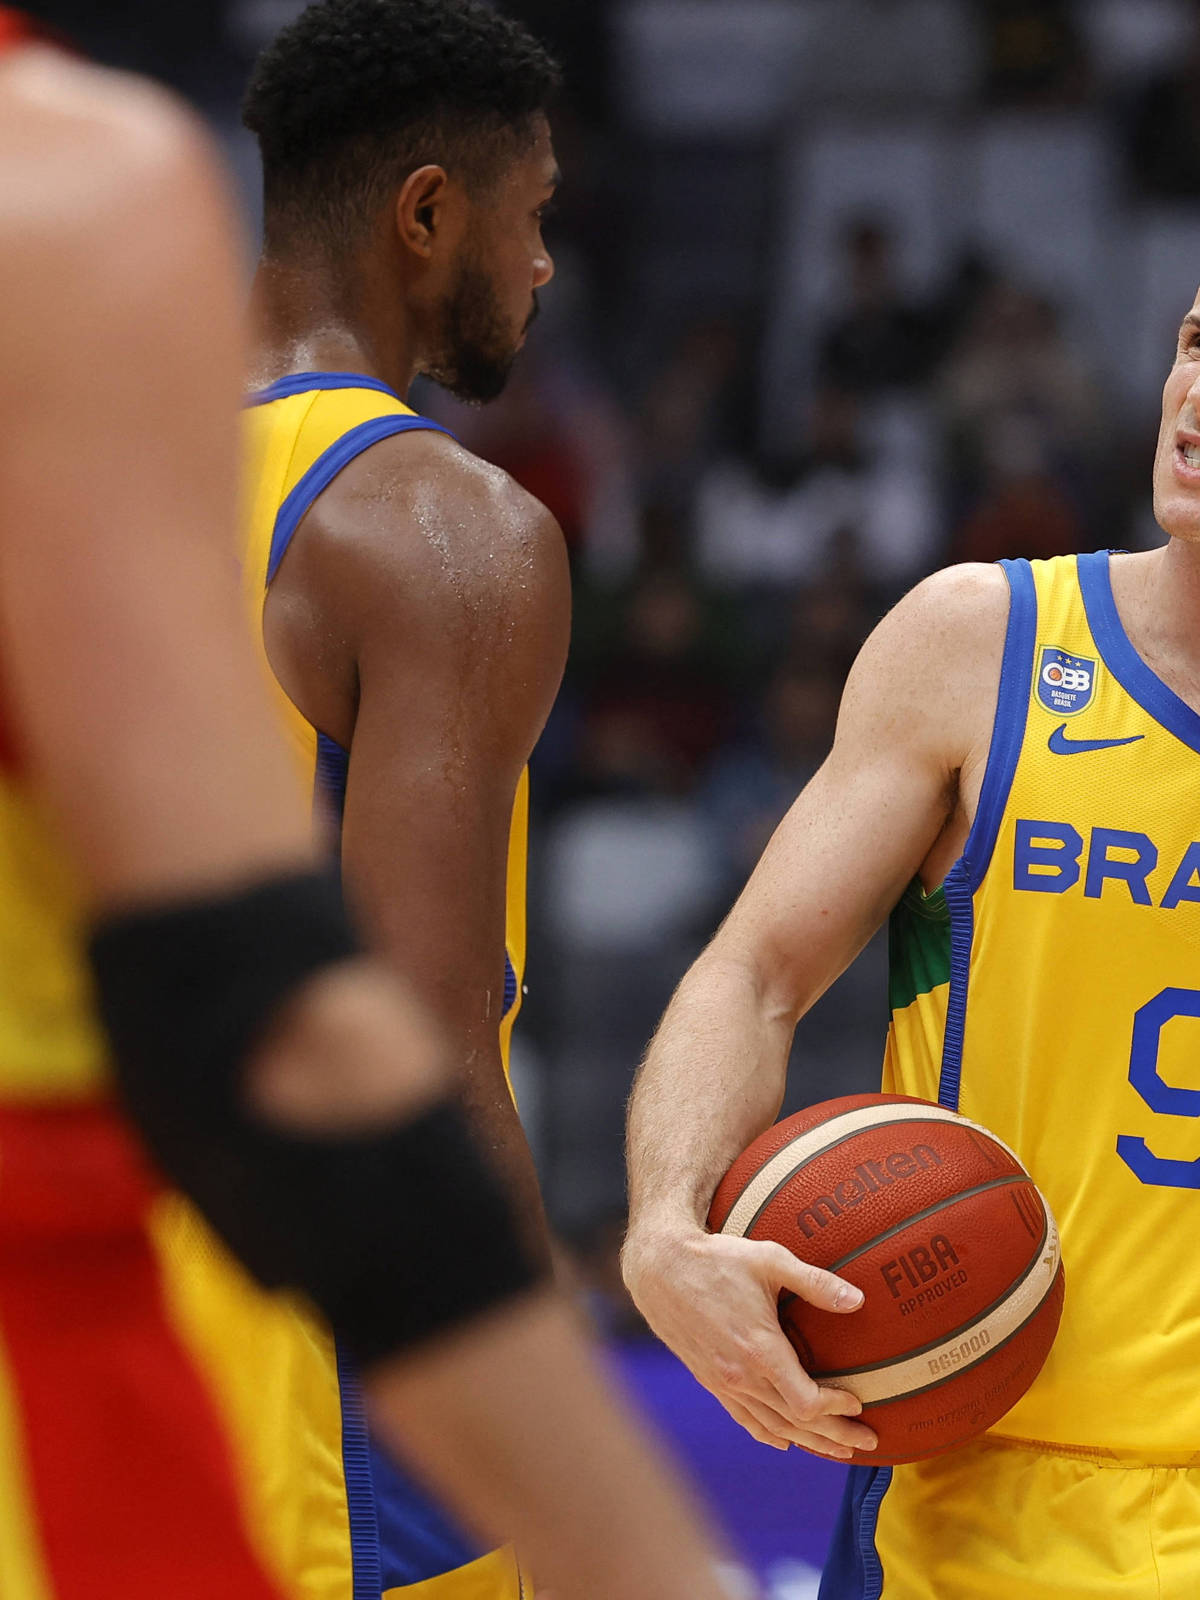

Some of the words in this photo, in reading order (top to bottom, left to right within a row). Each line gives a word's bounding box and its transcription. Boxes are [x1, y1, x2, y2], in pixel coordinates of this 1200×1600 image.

[797, 1144, 943, 1239] molten
[881, 1235, 960, 1299] FIBA
[900, 1270, 968, 1316] APPROVED
[927, 1329, 991, 1377] BG5000
